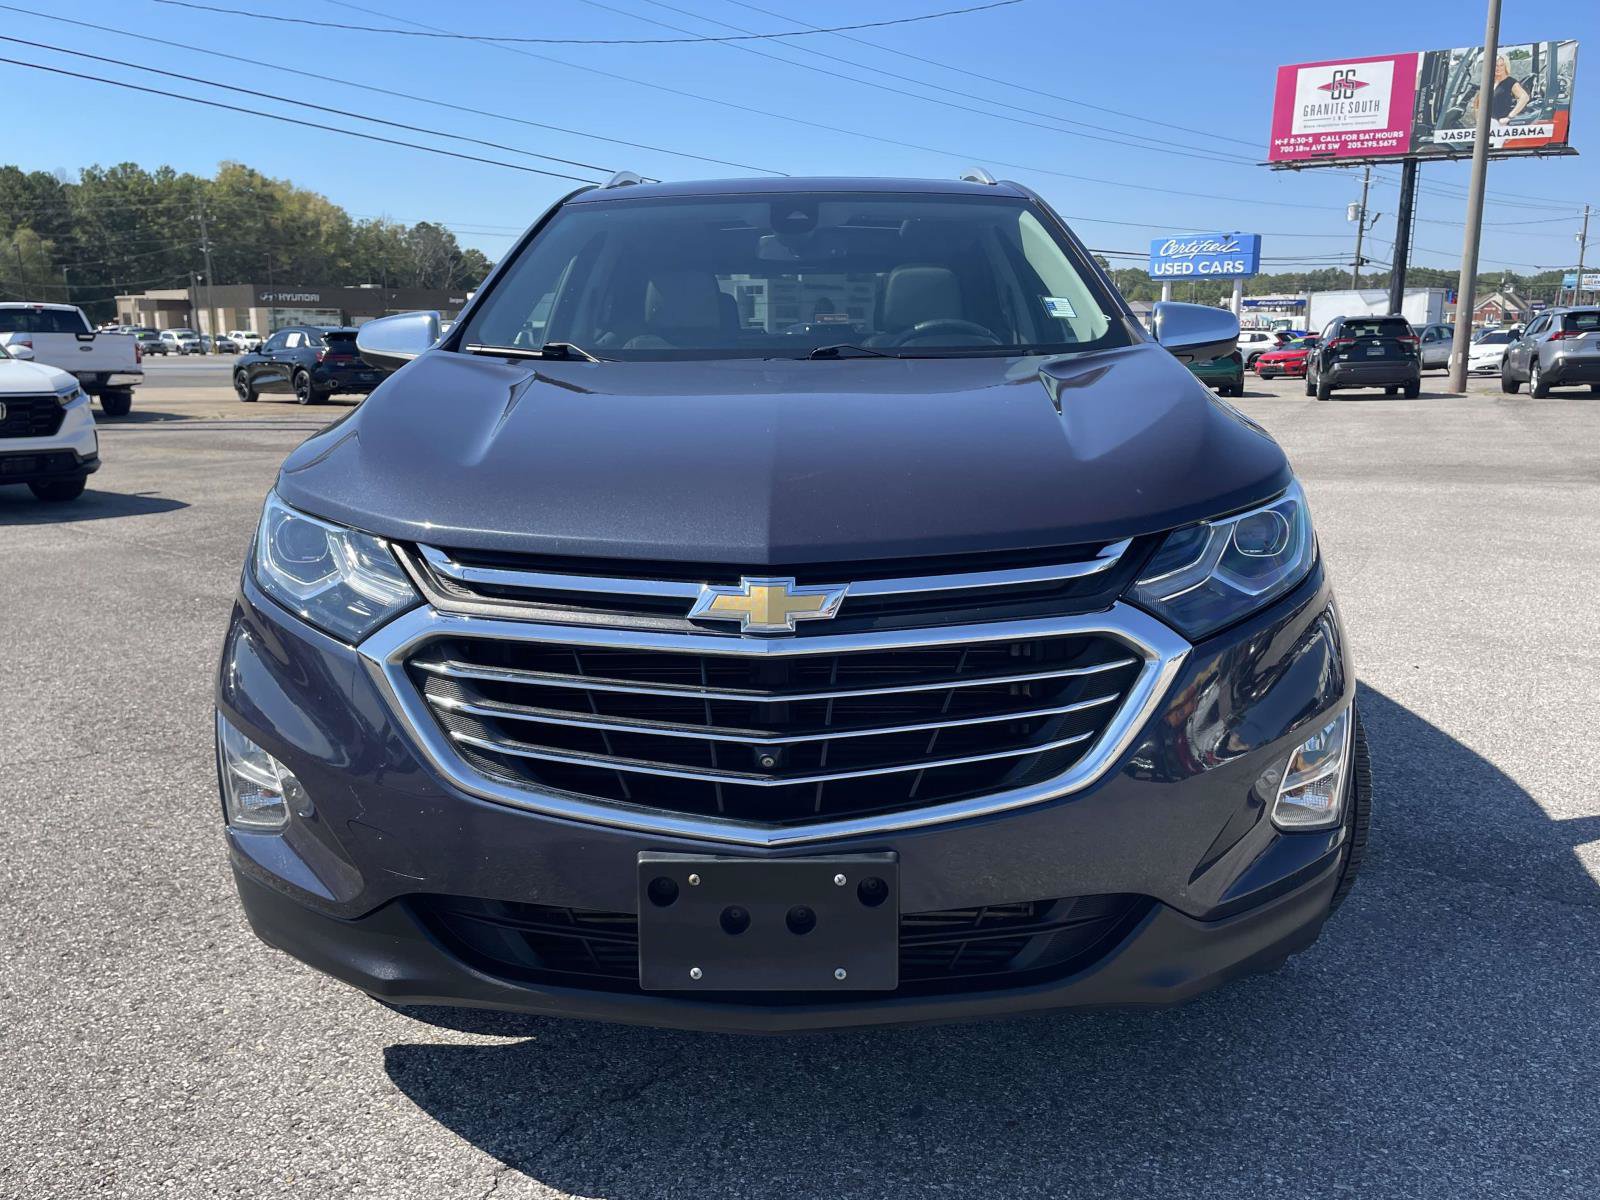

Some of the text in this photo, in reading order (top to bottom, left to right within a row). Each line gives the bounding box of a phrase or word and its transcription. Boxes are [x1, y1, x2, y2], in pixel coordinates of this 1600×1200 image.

[1303, 100, 1380, 117] GRANITE SOUTH
[1320, 131, 1404, 143] CALL FOR SAT HOURS
[1441, 127, 1545, 141] JASPE ALABAMA
[1280, 145, 1294, 153] 700
[1311, 143, 1327, 151] AVE
[1160, 240, 1240, 260] Certified
[1154, 260, 1244, 275] USED CARS
[278, 293, 320, 302] HYUNDAI
